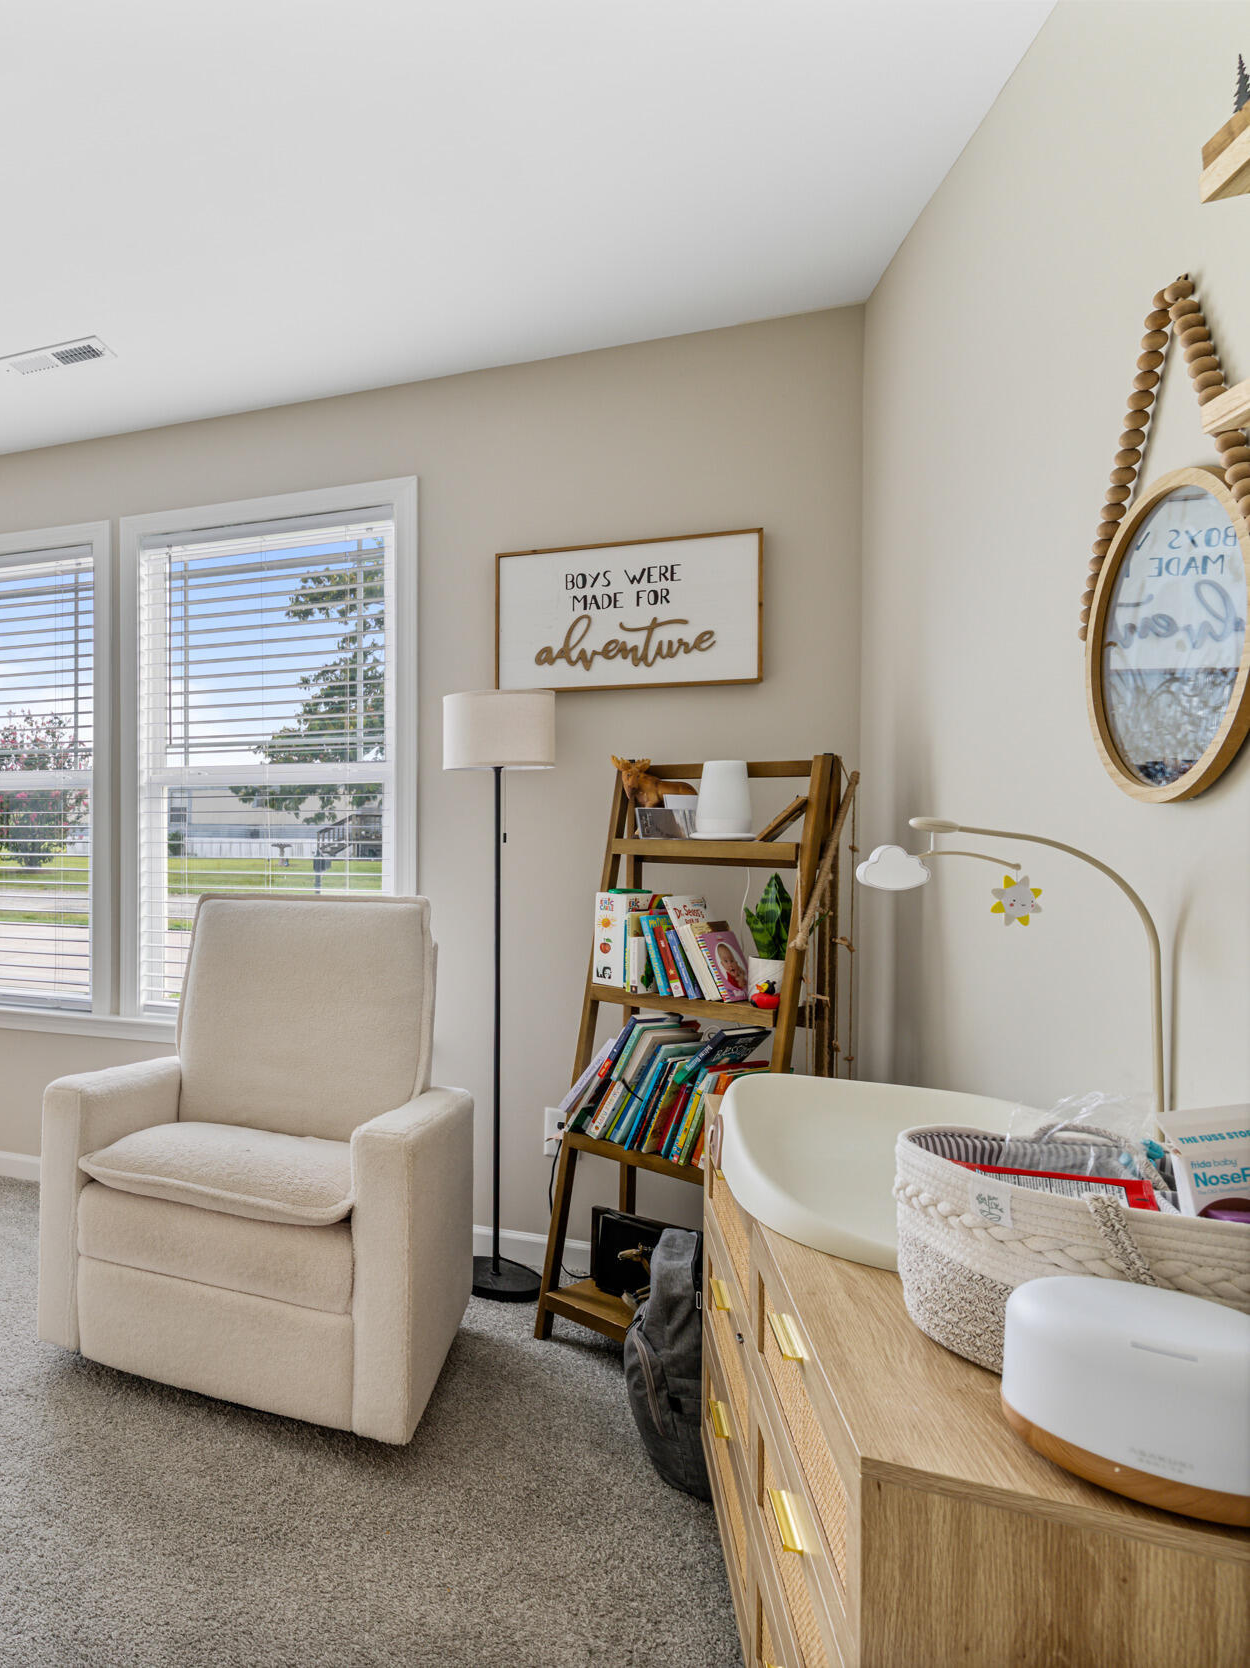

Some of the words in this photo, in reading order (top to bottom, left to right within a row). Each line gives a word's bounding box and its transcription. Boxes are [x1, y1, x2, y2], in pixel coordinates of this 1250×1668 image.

[565, 570, 611, 590] BOYS
[624, 563, 682, 585] WERE
[572, 591, 624, 611] MADE
[636, 588, 671, 607] FOR
[534, 614, 717, 671] adventure
[1178, 1136, 1199, 1144] THE
[1198, 1132, 1226, 1142] FUSS
[1190, 1160, 1212, 1169] frida
[1213, 1158, 1237, 1168] baby
